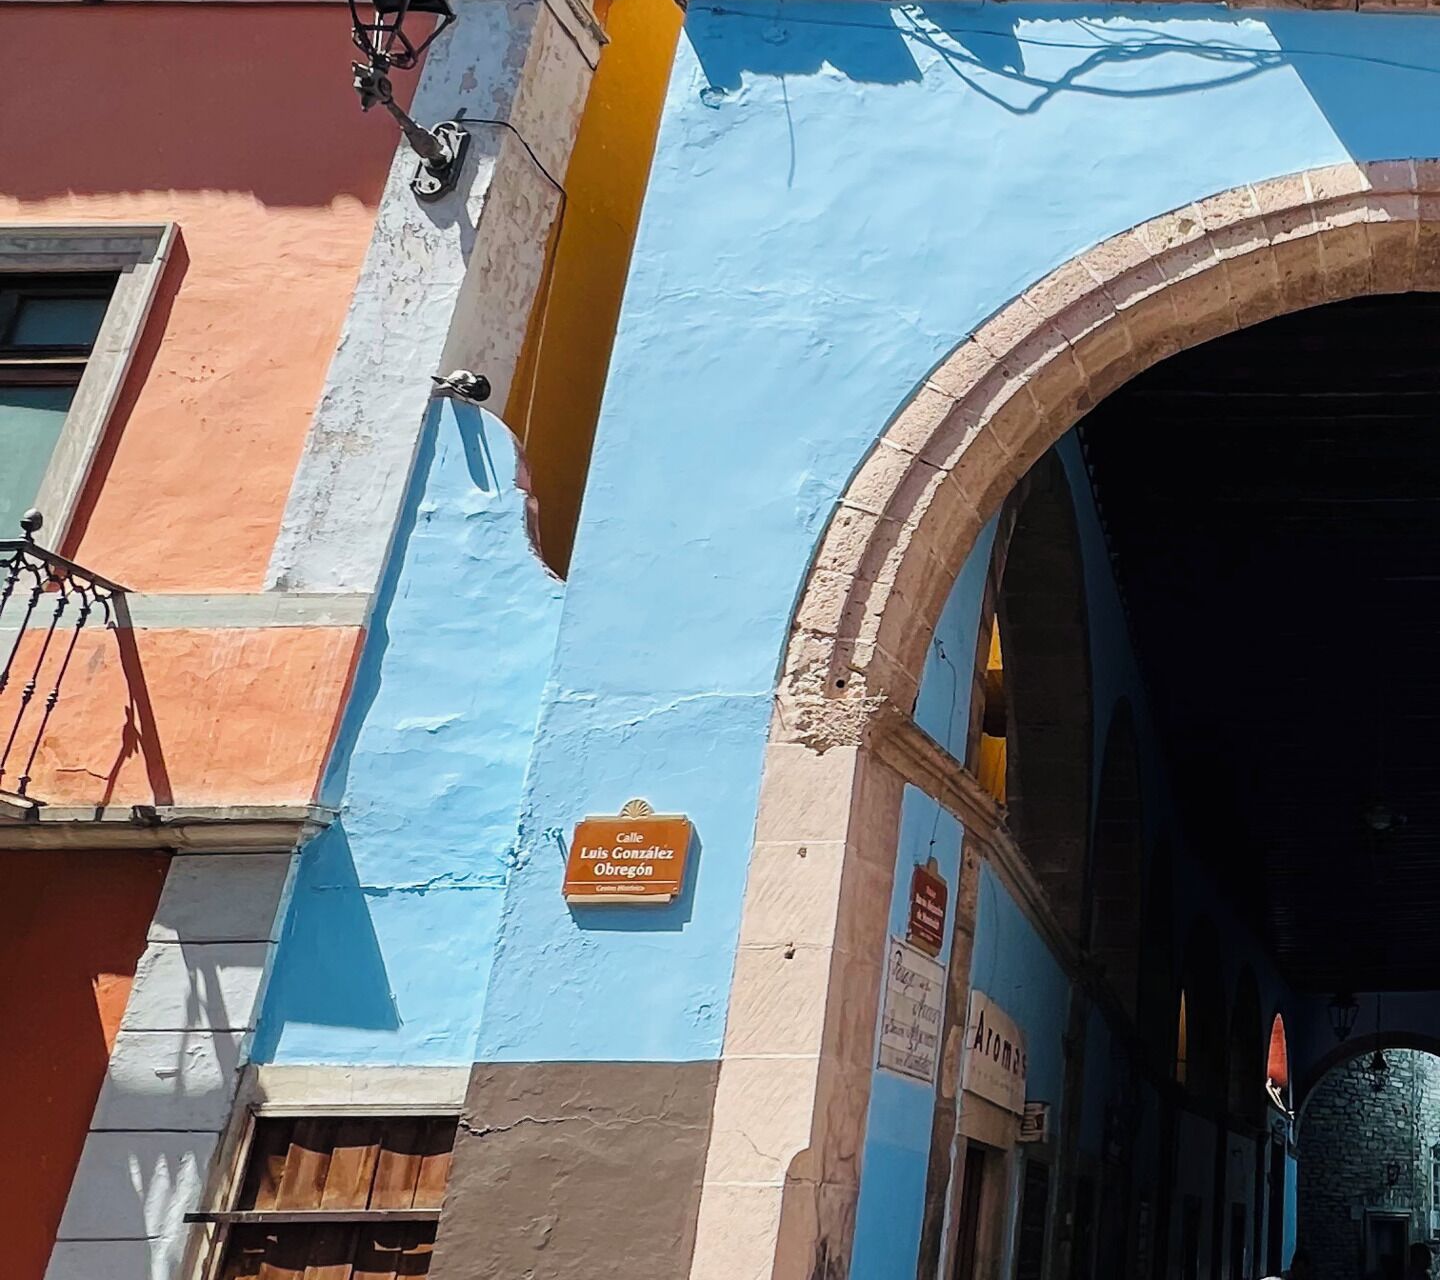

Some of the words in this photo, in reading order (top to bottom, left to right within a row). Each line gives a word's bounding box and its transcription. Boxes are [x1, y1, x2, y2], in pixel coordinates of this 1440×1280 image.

[616, 832, 644, 843] Calle
[580, 846, 609, 859] Luis
[611, 845, 674, 859] González
[594, 862, 653, 878] Obregón
[974, 1010, 1027, 1080] Aromas
